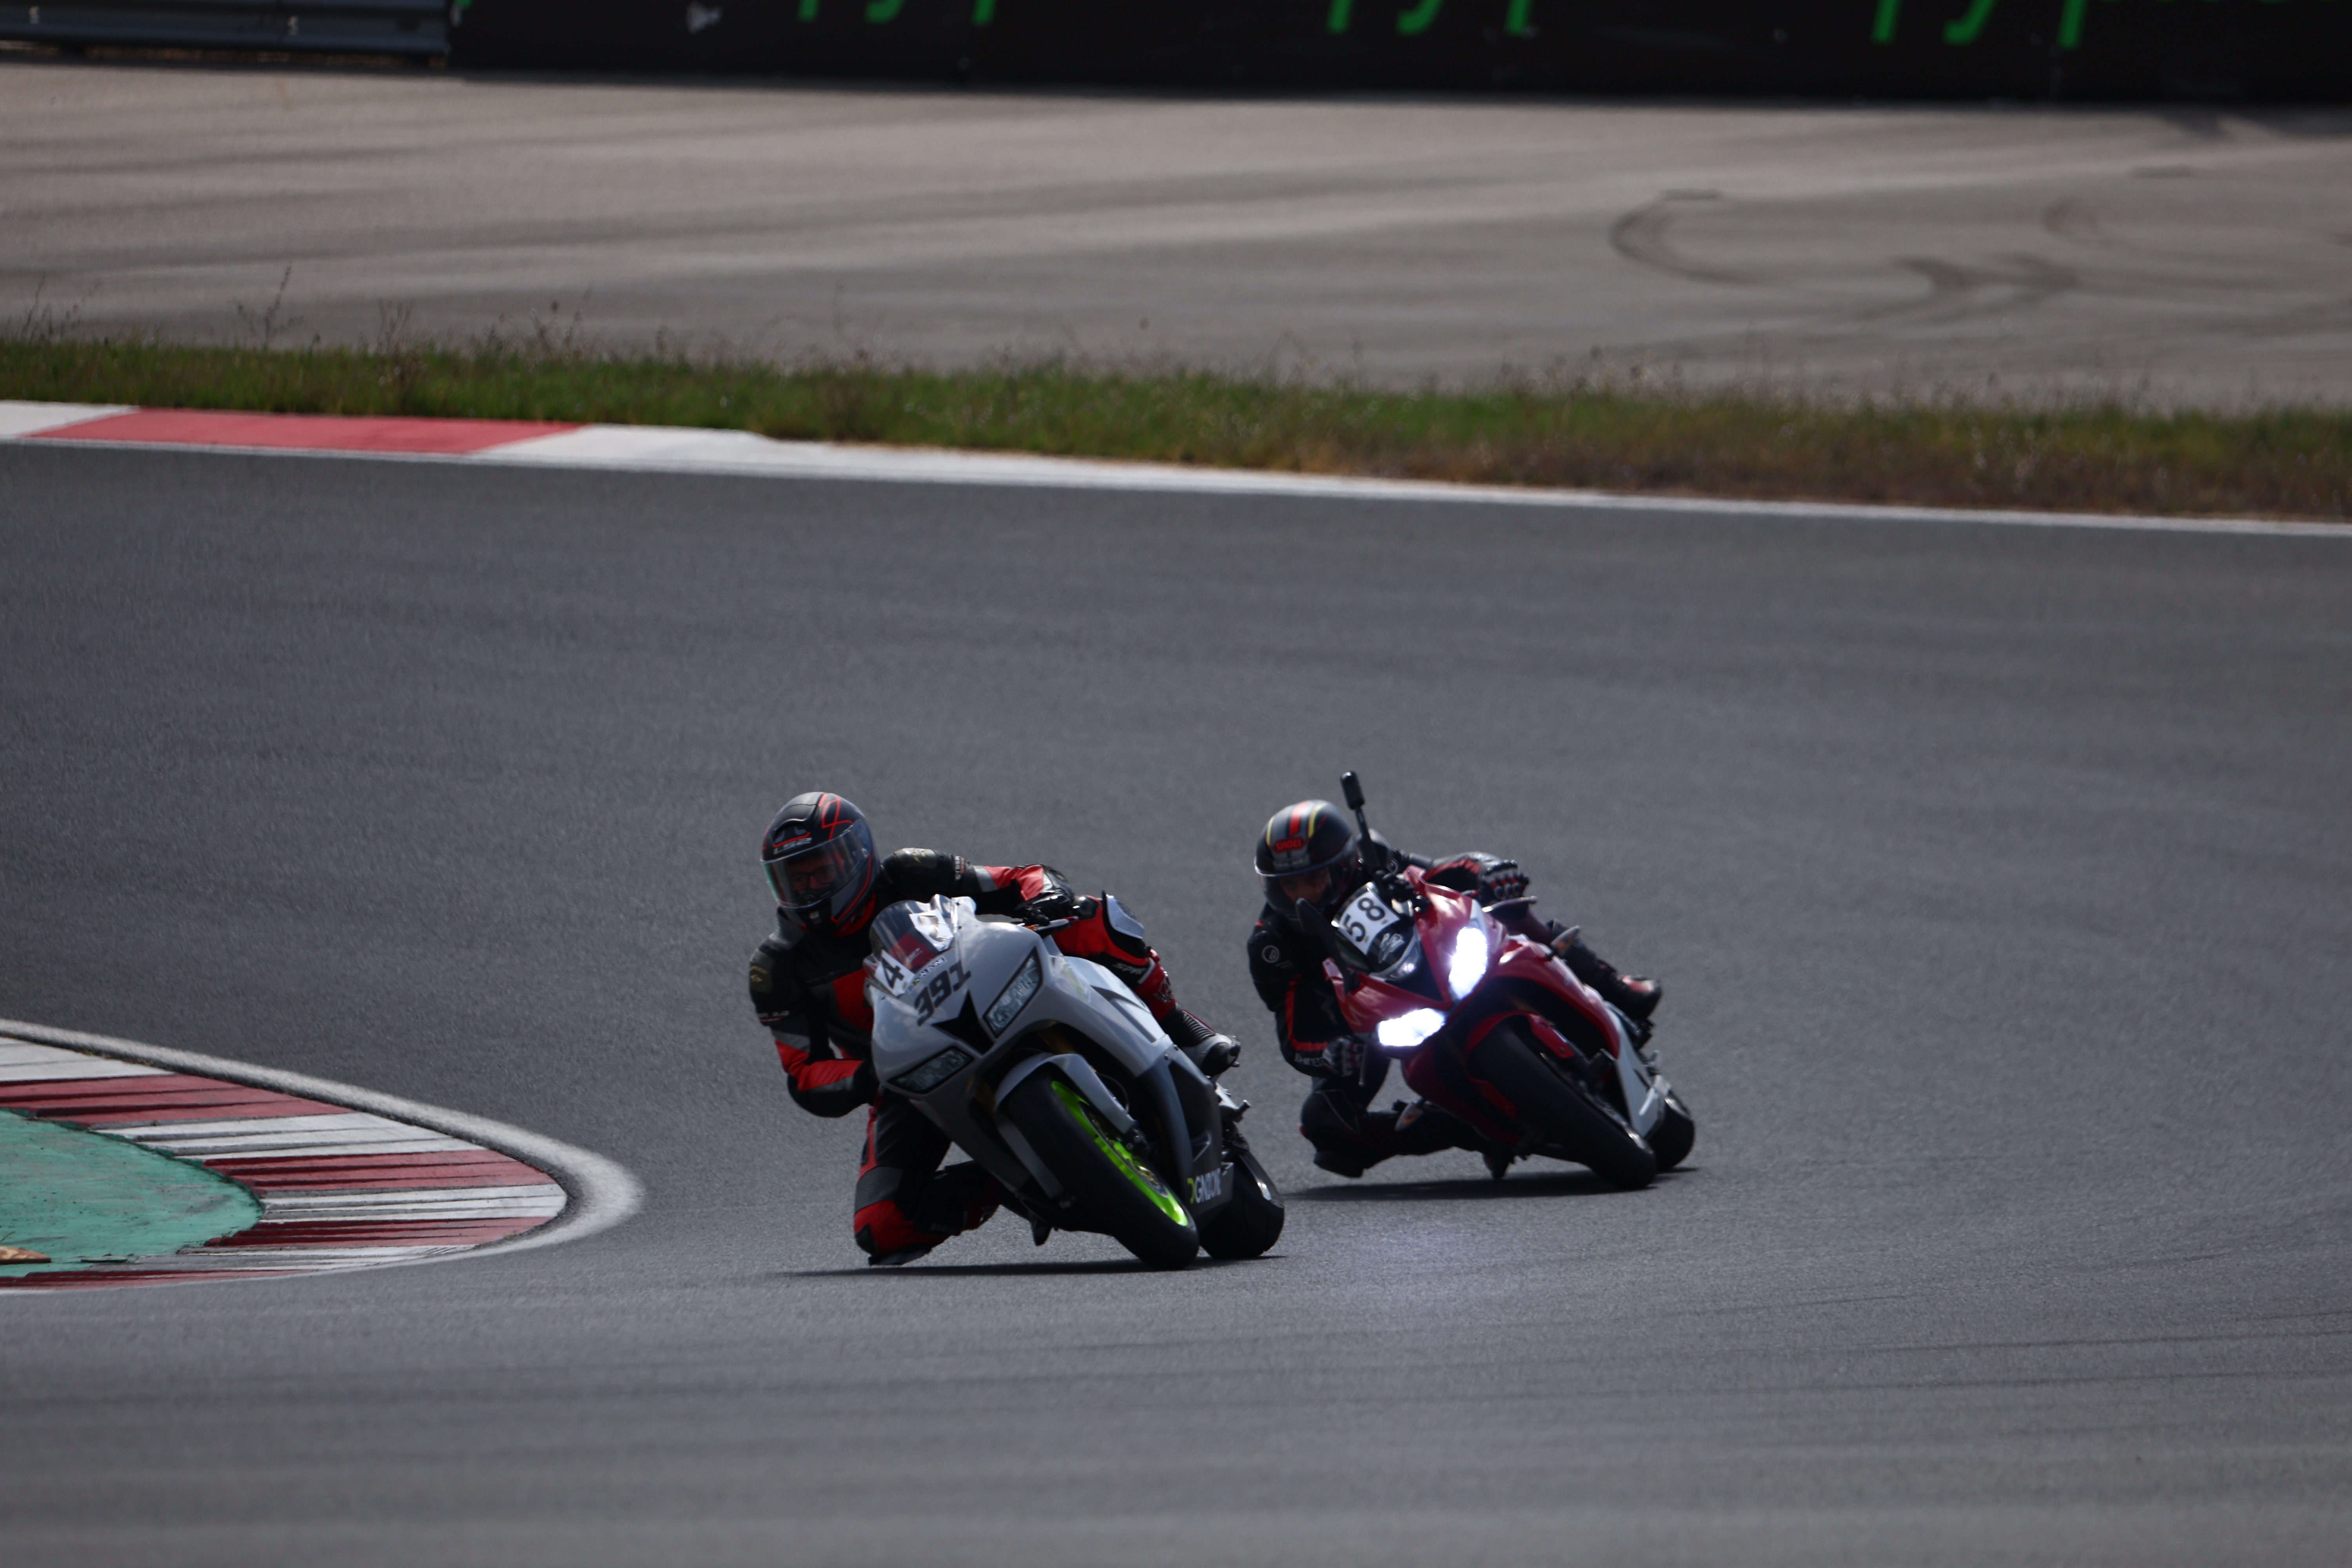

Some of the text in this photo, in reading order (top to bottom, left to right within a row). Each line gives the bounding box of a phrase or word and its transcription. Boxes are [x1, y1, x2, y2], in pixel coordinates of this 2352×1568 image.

[773, 837, 812, 855] LS2
[1276, 839, 1302, 850] SHOEI
[1343, 897, 1385, 942] 58
[881, 958, 904, 989] 4
[914, 960, 971, 1026] 391
